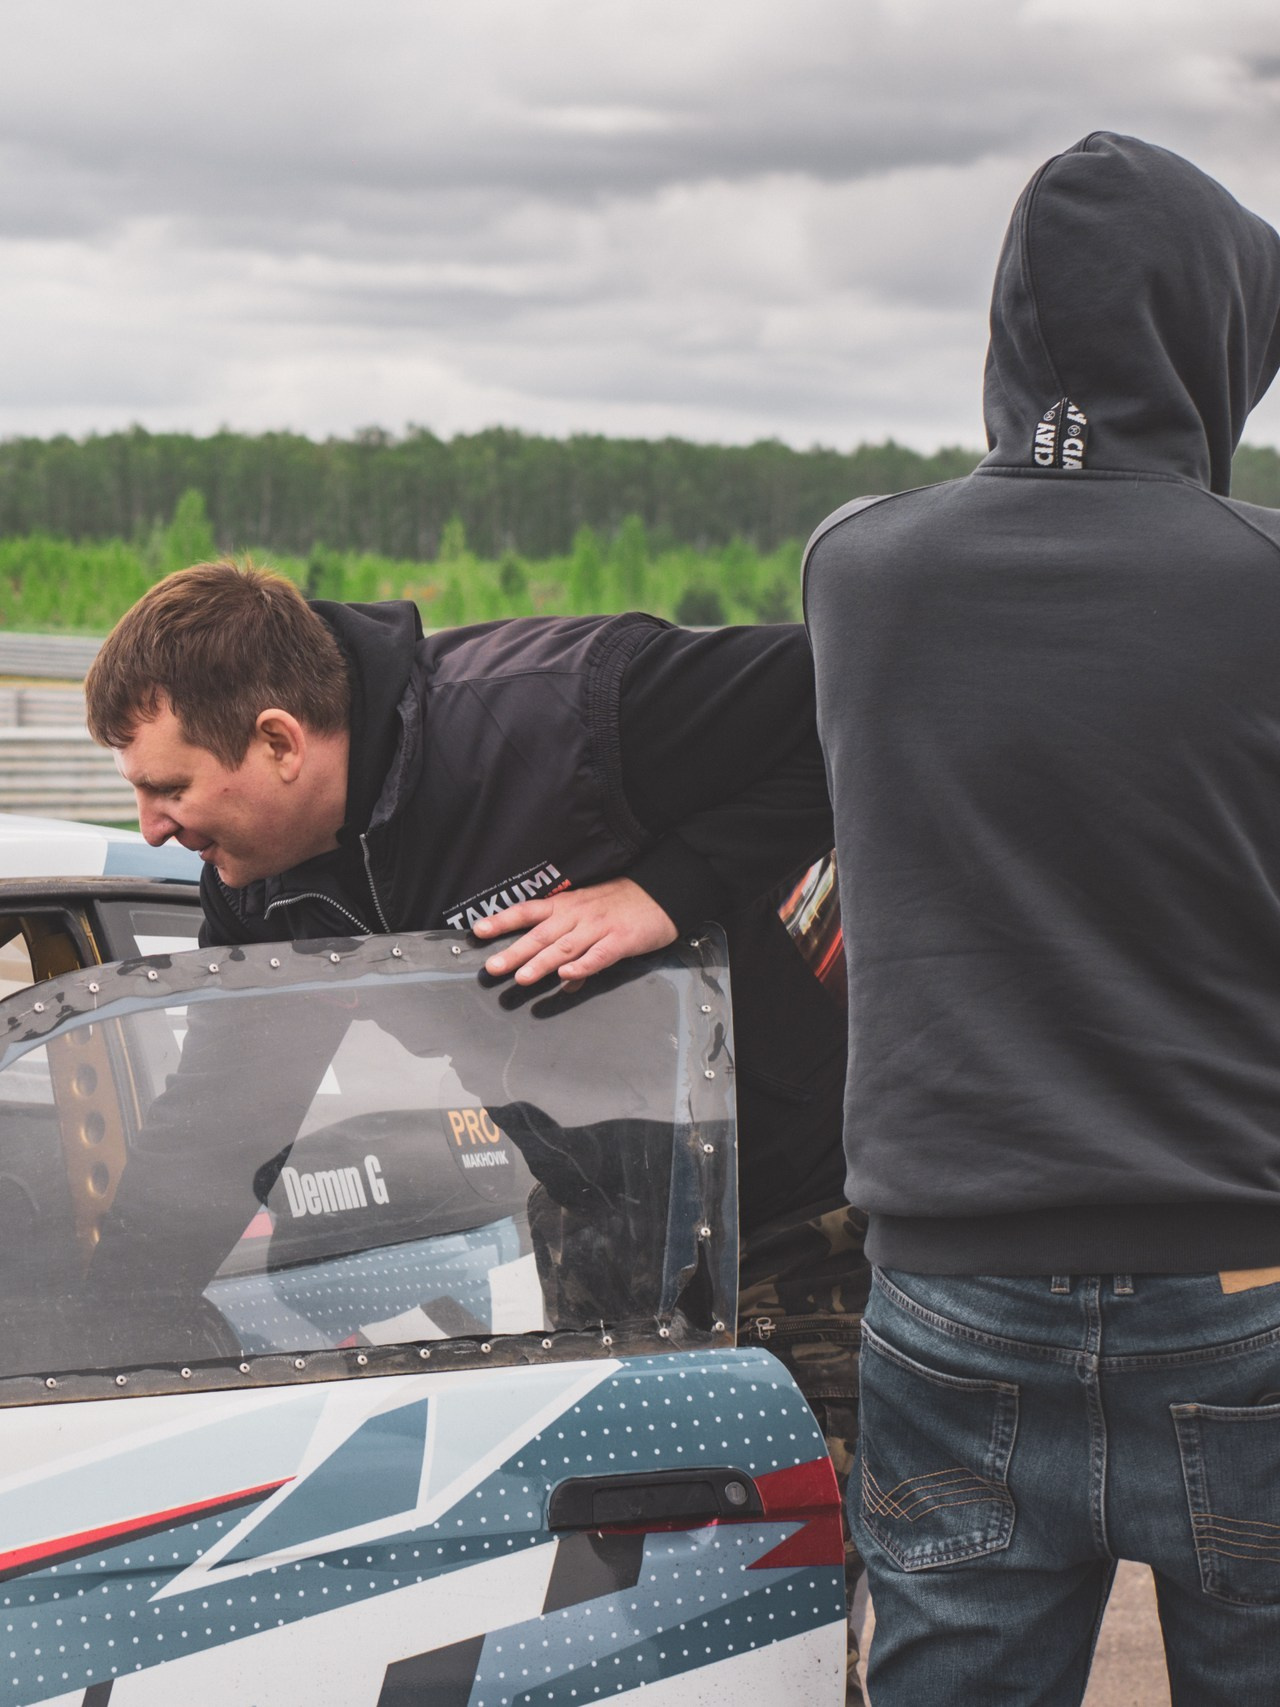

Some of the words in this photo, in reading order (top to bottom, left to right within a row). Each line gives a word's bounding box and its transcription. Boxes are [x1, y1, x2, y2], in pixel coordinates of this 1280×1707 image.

[446, 863, 561, 930] TAKUMI
[448, 1108, 500, 1146] PRO
[364, 1155, 389, 1204] G
[462, 1150, 509, 1168] MAKHOVIK
